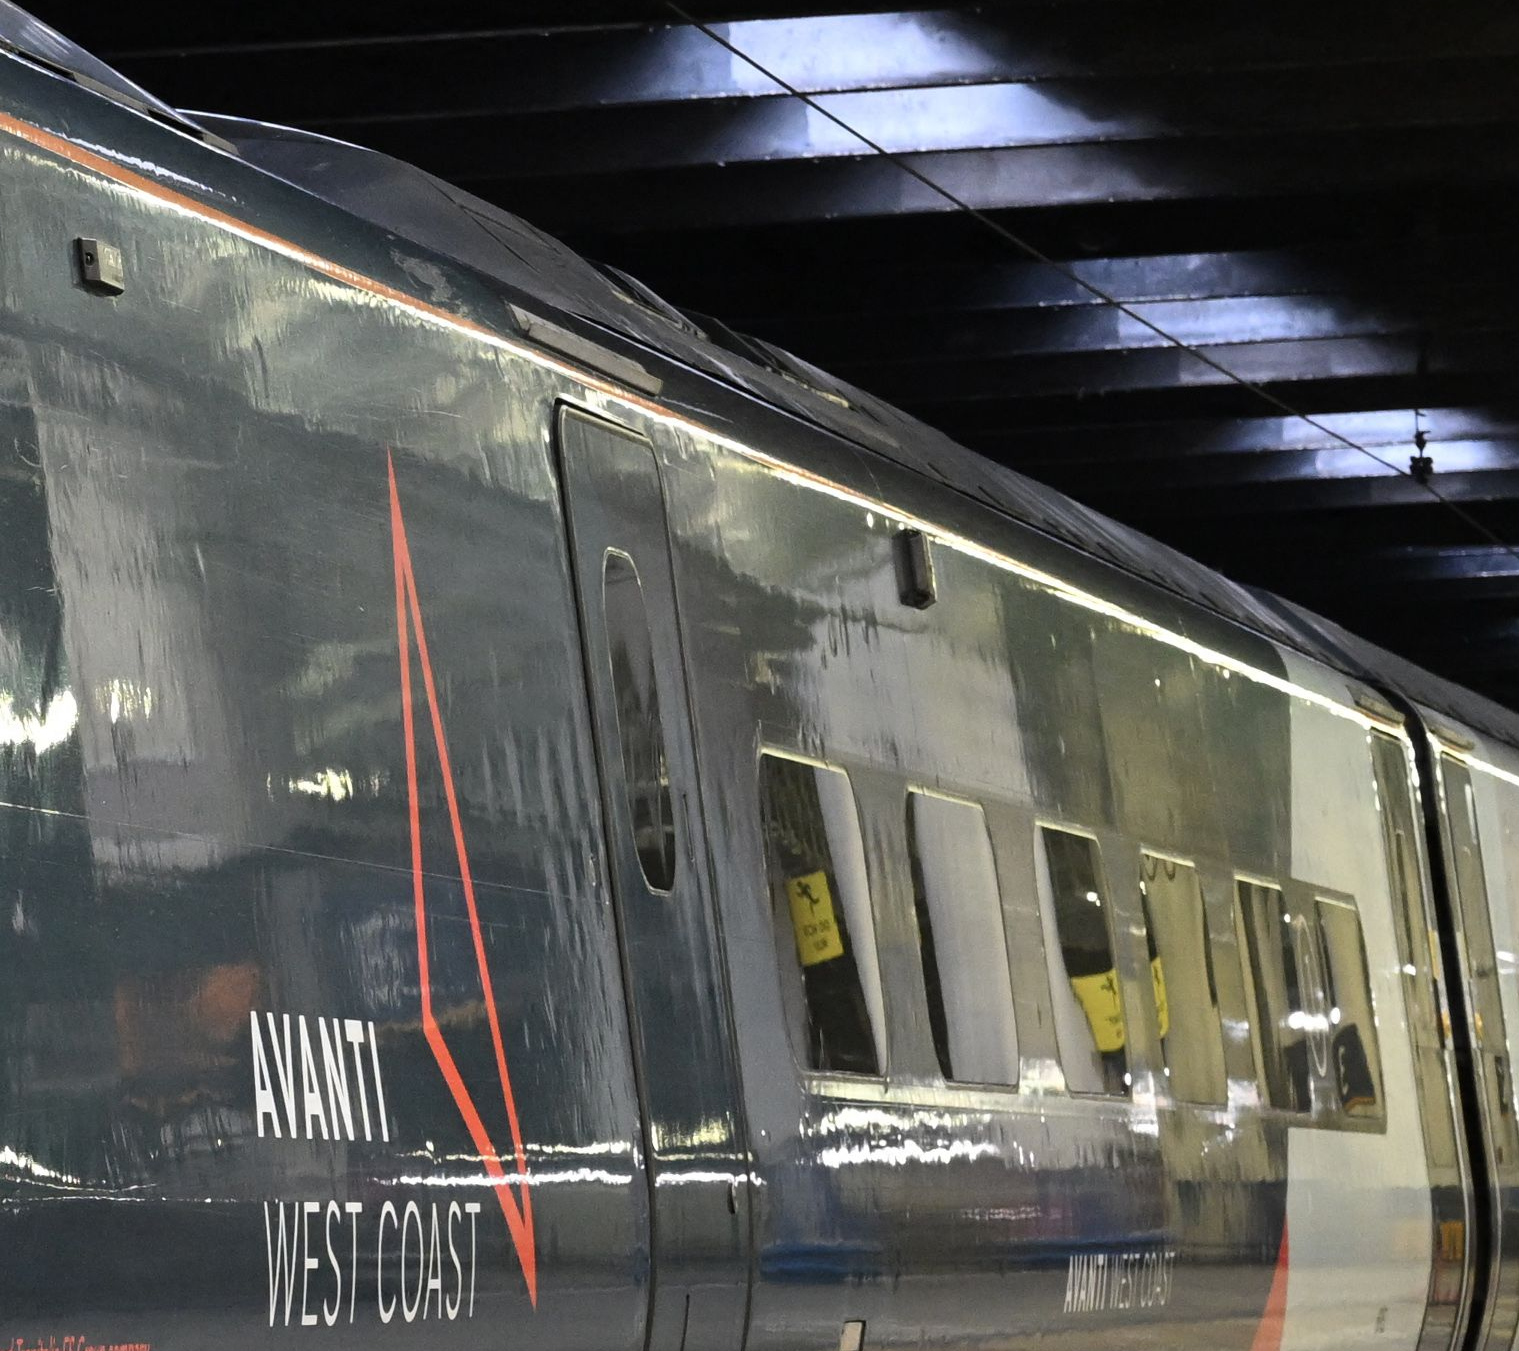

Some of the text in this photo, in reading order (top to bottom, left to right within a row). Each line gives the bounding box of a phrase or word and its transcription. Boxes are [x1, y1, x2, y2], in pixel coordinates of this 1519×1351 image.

[249, 1010, 391, 1142] AVANTI
[265, 1200, 481, 1328] WEST COAST
[1064, 1251, 1176, 1313] AVANTI WEST COAST
